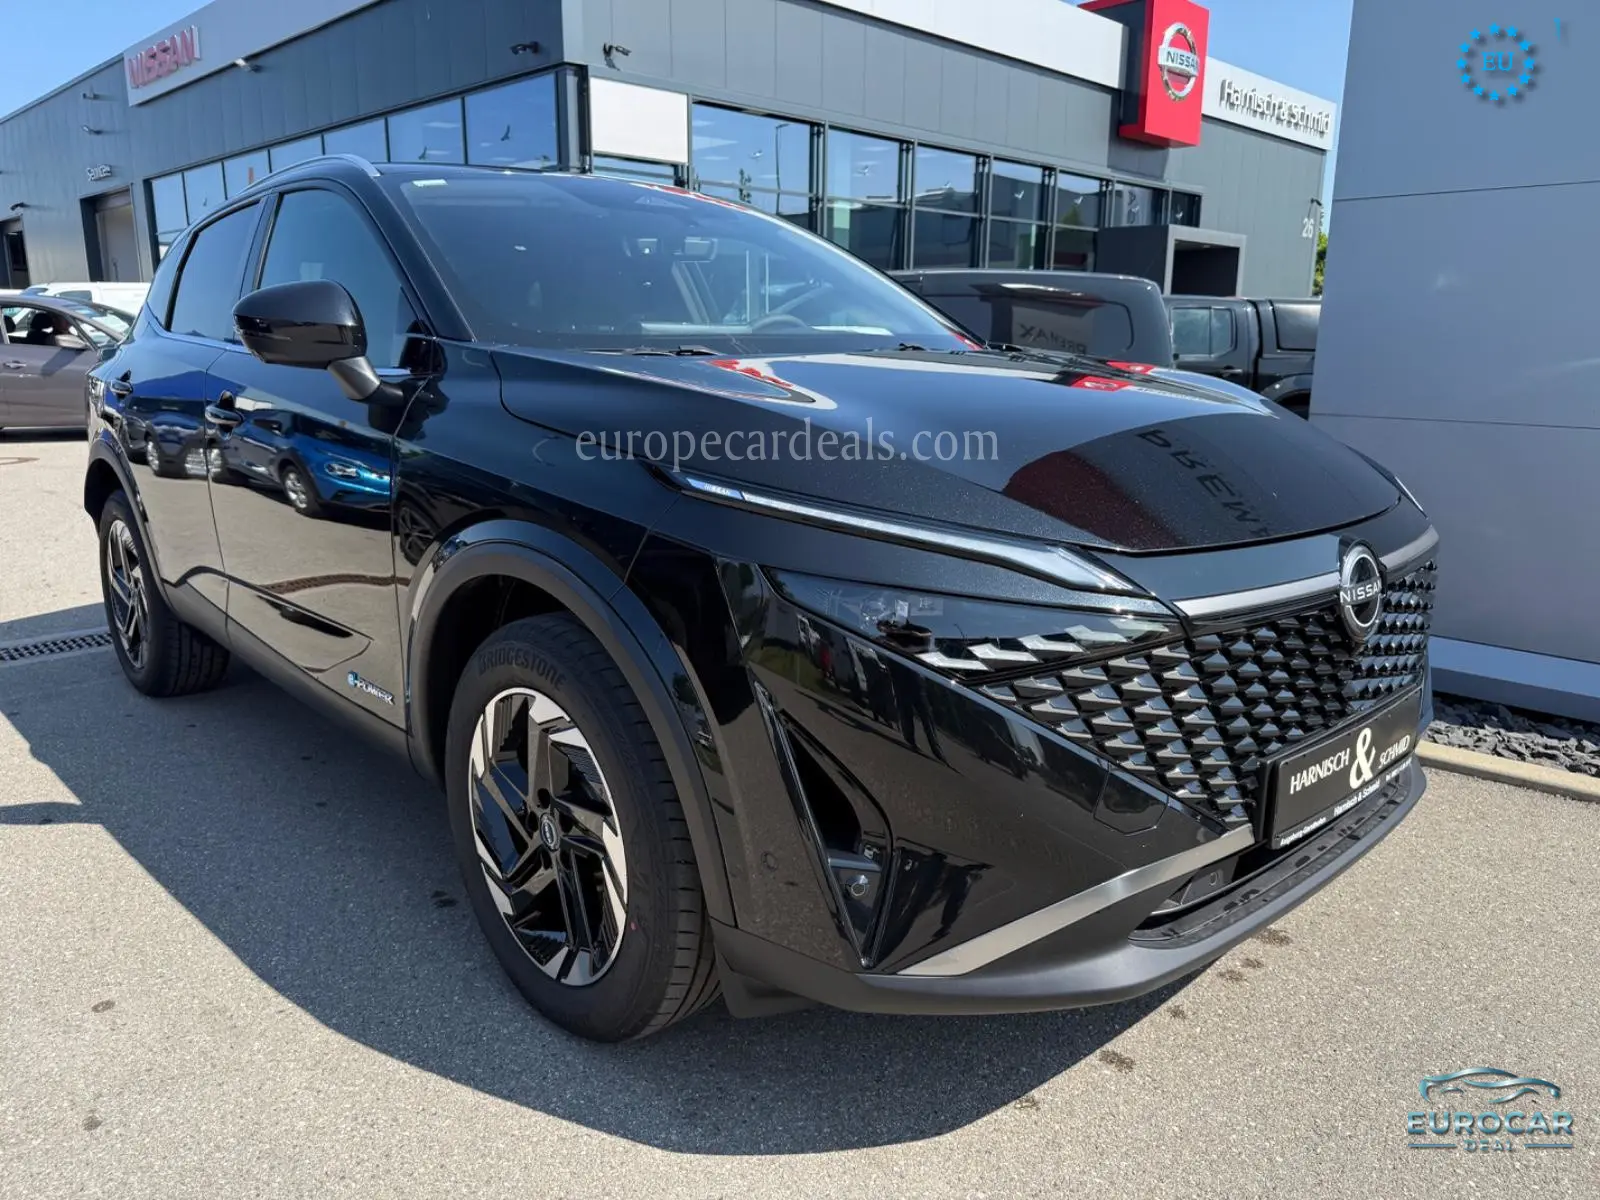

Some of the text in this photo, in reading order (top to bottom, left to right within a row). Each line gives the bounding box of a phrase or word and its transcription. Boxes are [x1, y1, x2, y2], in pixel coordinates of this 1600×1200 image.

[129, 25, 199, 89] NISSAN
[1220, 80, 1278, 117] Harnisch
[1291, 102, 1332, 134] Schmid
[1302, 217, 1314, 238] 26
[480, 645, 567, 692] BRIDGESTONE
[1290, 747, 1350, 795] HARNISCH
[1349, 727, 1376, 789] &
[1378, 734, 1410, 769] SCHMID
